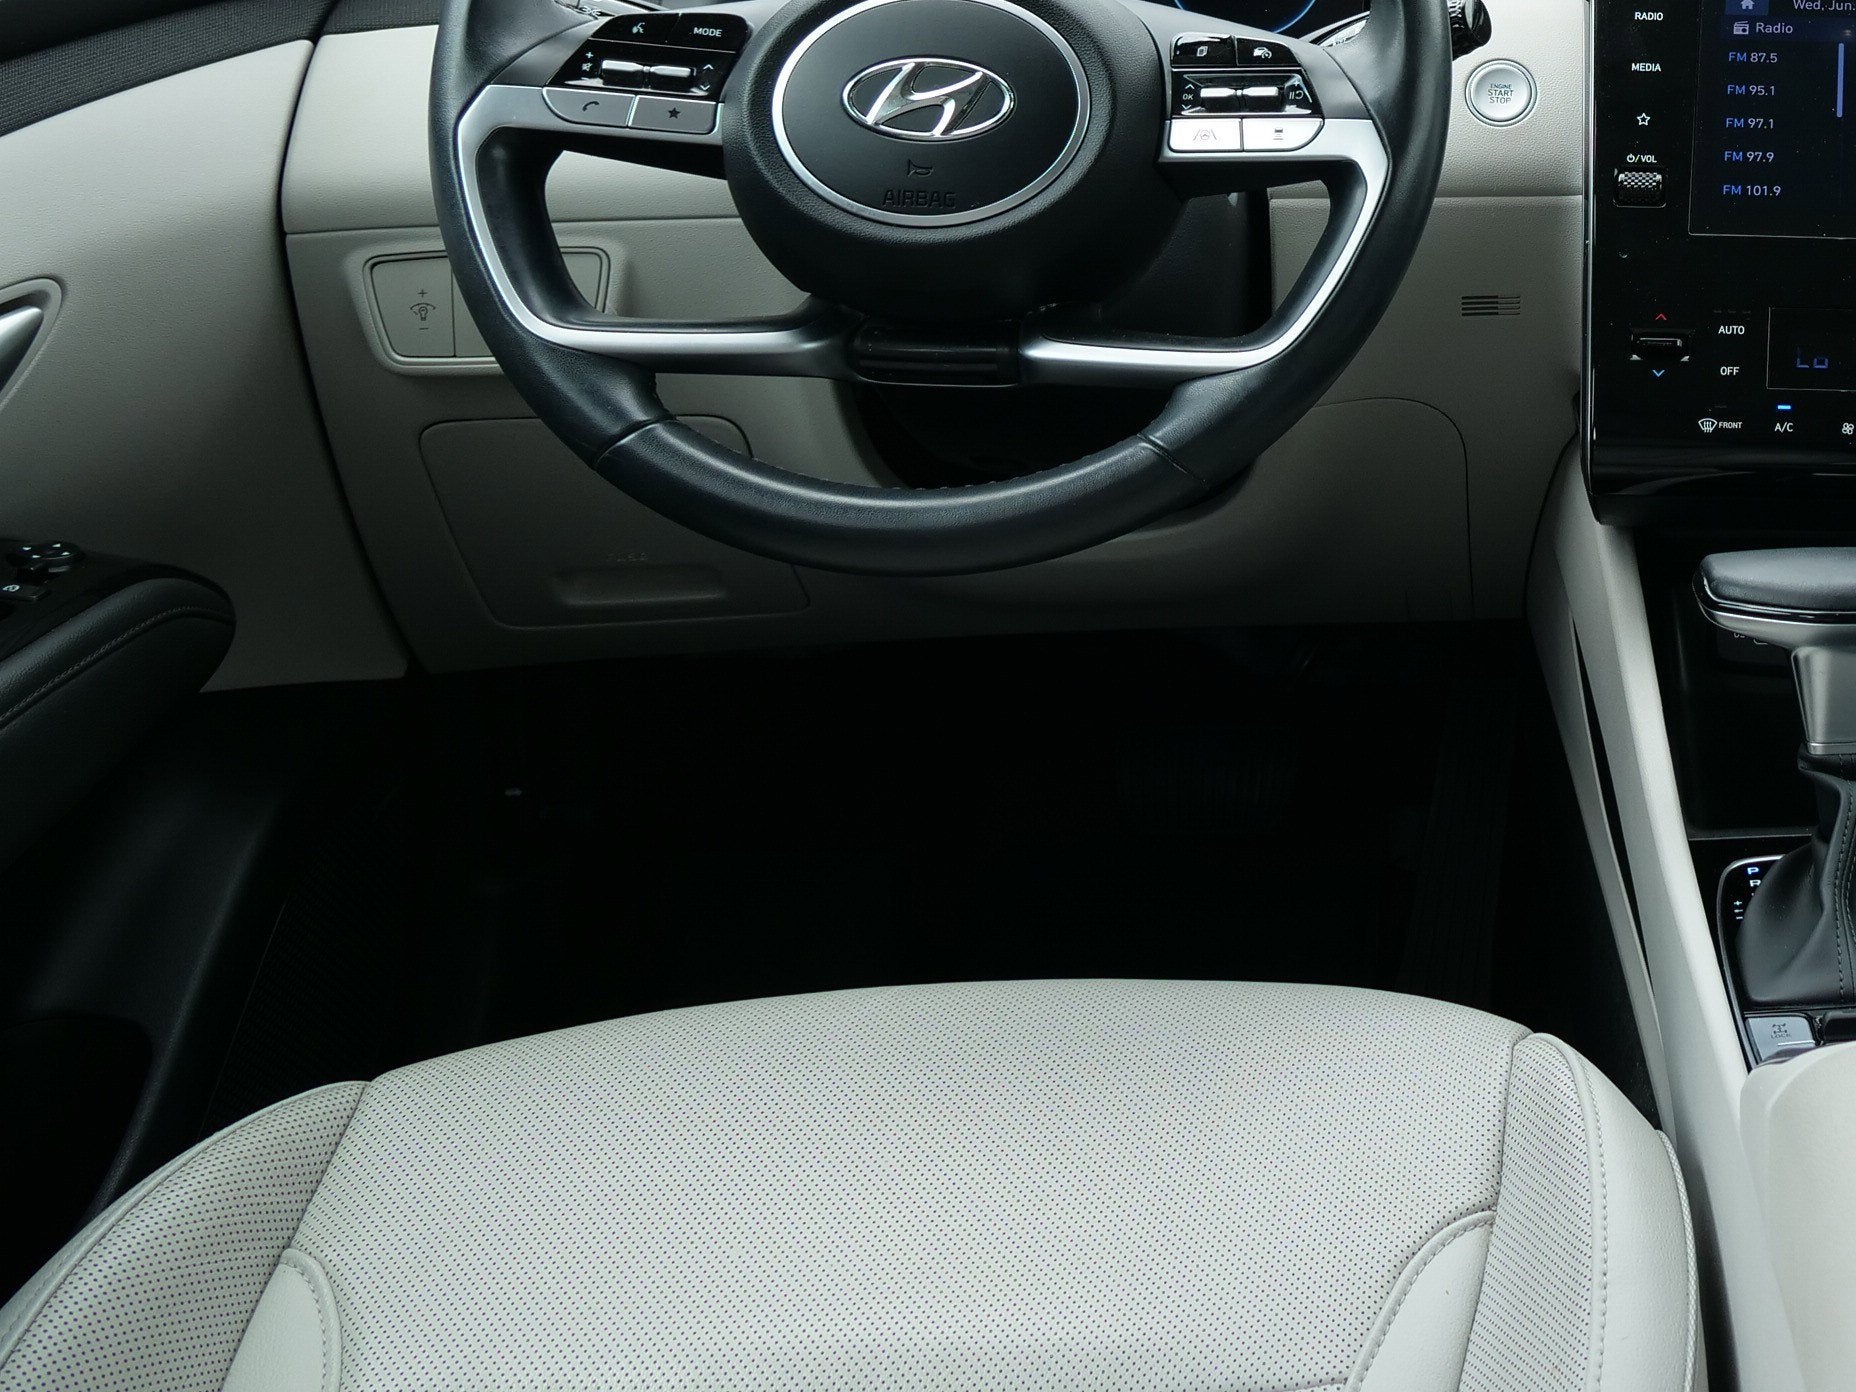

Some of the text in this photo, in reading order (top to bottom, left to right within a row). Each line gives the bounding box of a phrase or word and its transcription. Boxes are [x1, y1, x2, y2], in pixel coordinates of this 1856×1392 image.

[1826, 0, 1856, 12] Jun.
[1634, 11, 1664, 21] RADIO
[693, 26, 723, 37] MODE
[1755, 22, 1794, 34] Radio
[1728, 51, 1778, 63] FM 87.5
[1631, 62, 1662, 72] MEDIA
[1488, 89, 1514, 97] START
[1727, 84, 1775, 96] FM 95.1
[1182, 92, 1194, 100] OK
[1490, 97, 1511, 105] STOP
[1726, 117, 1774, 129] FM 97.1
[1724, 150, 1775, 163] FM 97.9
[1723, 184, 1782, 197] FM 101.9
[882, 189, 957, 208] AIRBAG
[1718, 325, 1745, 335] AUTO
[1720, 366, 1740, 376] OFF
[1718, 421, 1743, 430] FRONT
[1774, 421, 1794, 433] A/C
[1746, 866, 1760, 875] P
[1749, 879, 1761, 887] R
